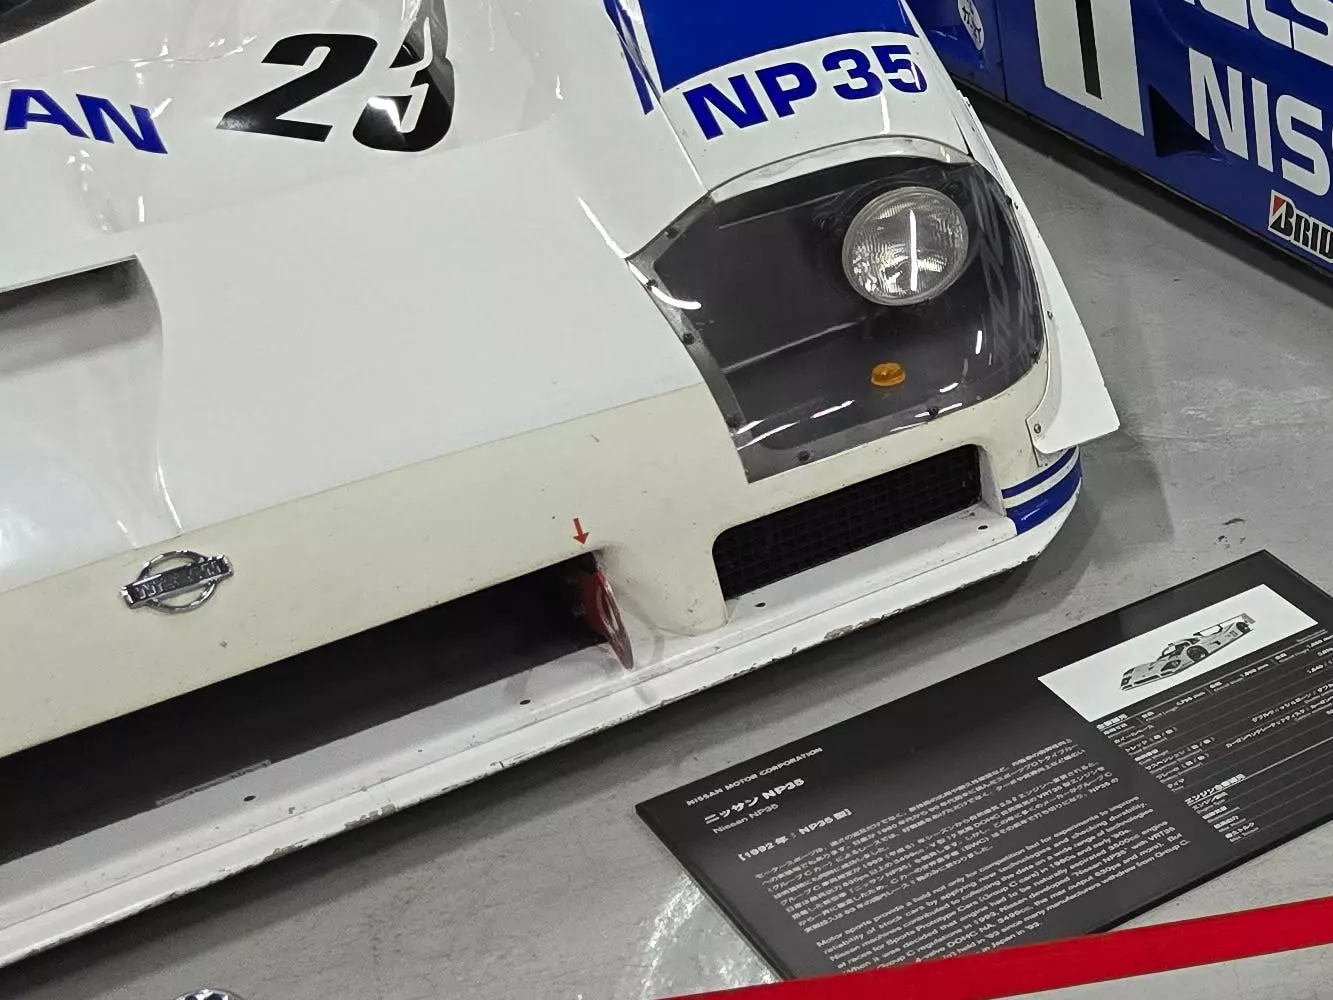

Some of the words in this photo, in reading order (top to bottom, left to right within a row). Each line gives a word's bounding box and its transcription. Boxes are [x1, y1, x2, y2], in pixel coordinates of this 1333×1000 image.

[684, 42, 930, 141] NP35
[685, 786, 724, 806] NISSAN
[722, 772, 760, 790] MOTOR
[756, 745, 824, 776] CORPORATION
